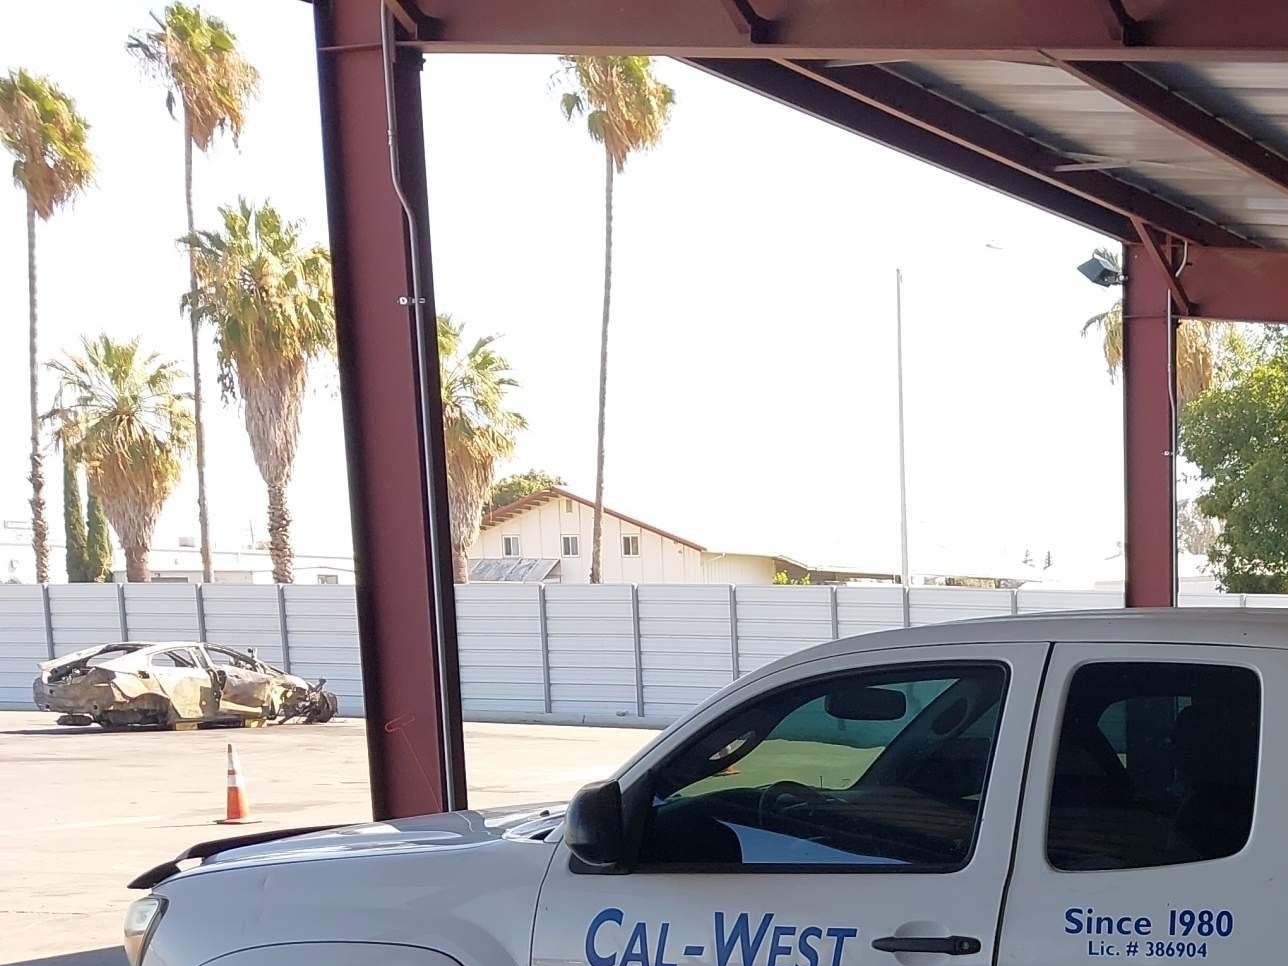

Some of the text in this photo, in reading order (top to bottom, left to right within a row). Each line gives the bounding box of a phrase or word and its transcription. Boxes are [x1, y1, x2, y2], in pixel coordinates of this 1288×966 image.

[1064, 907, 1234, 938] Since 1980
[1088, 940, 1208, 958] Lic. # 386904
